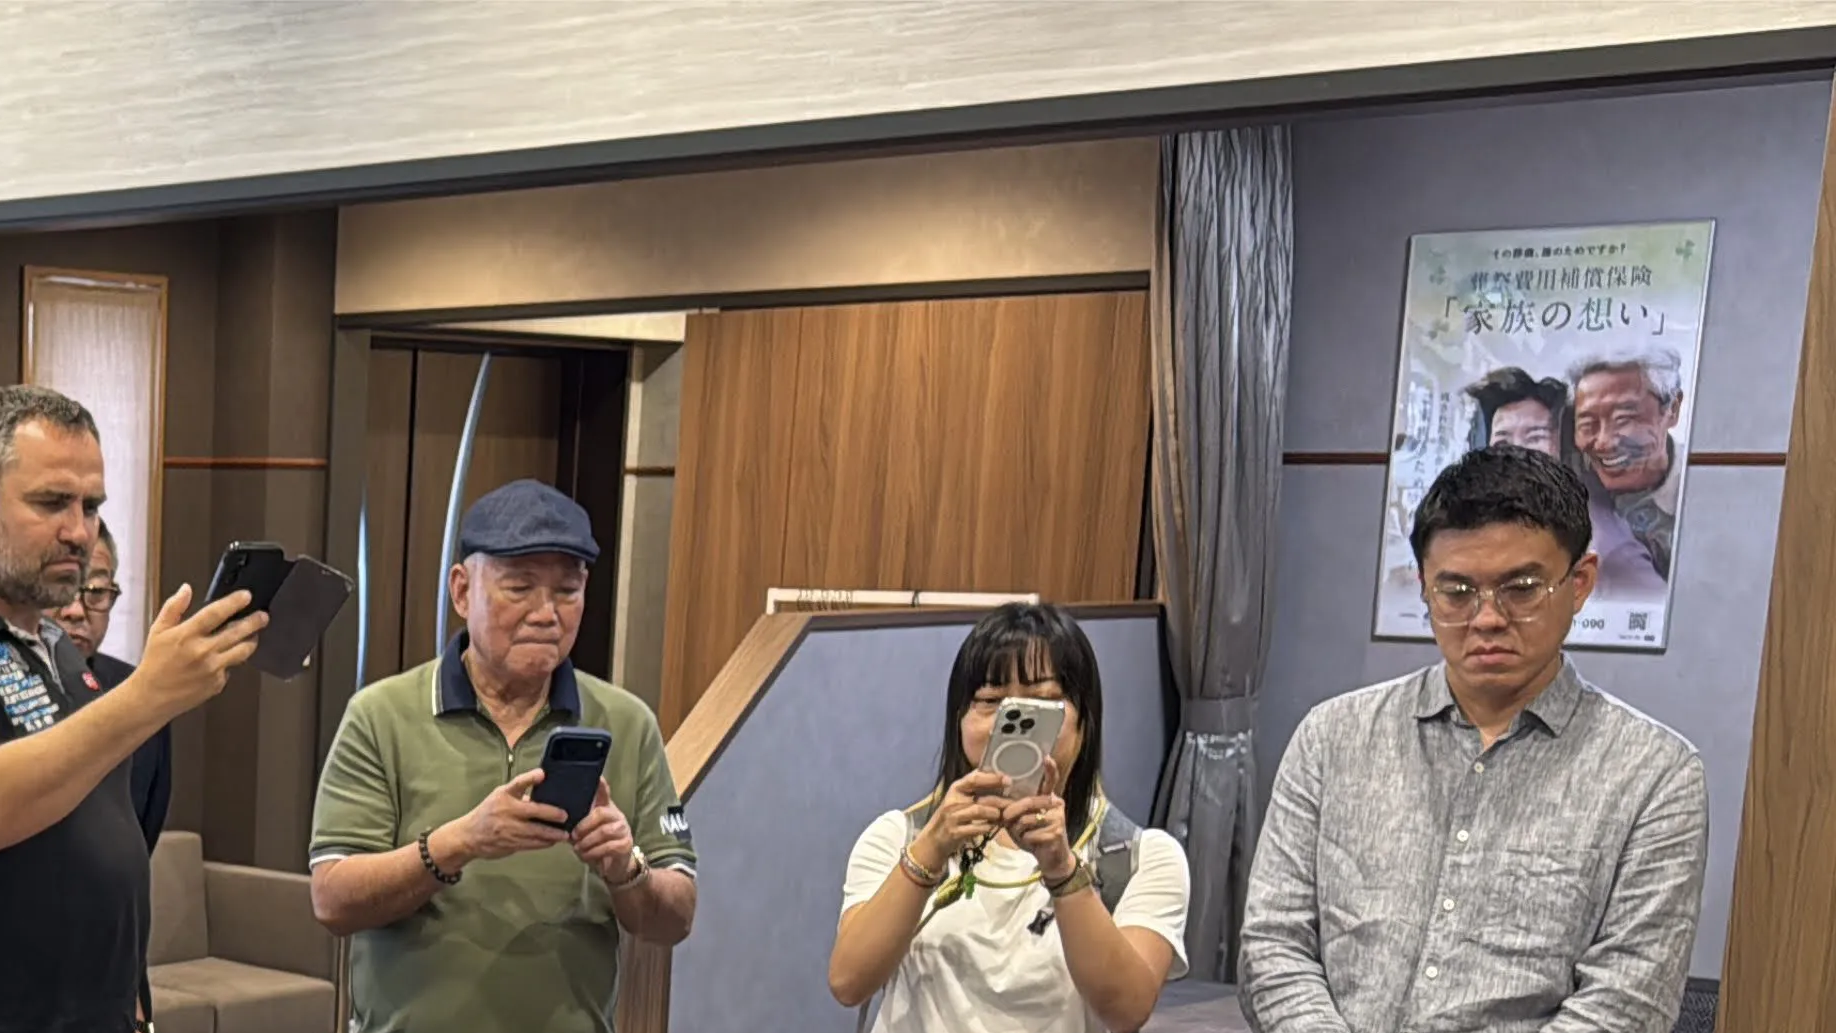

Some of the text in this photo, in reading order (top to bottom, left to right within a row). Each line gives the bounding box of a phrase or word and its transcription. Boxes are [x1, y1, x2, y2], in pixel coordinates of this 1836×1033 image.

[1445, 296, 1665, 336] 「家族の想い」
